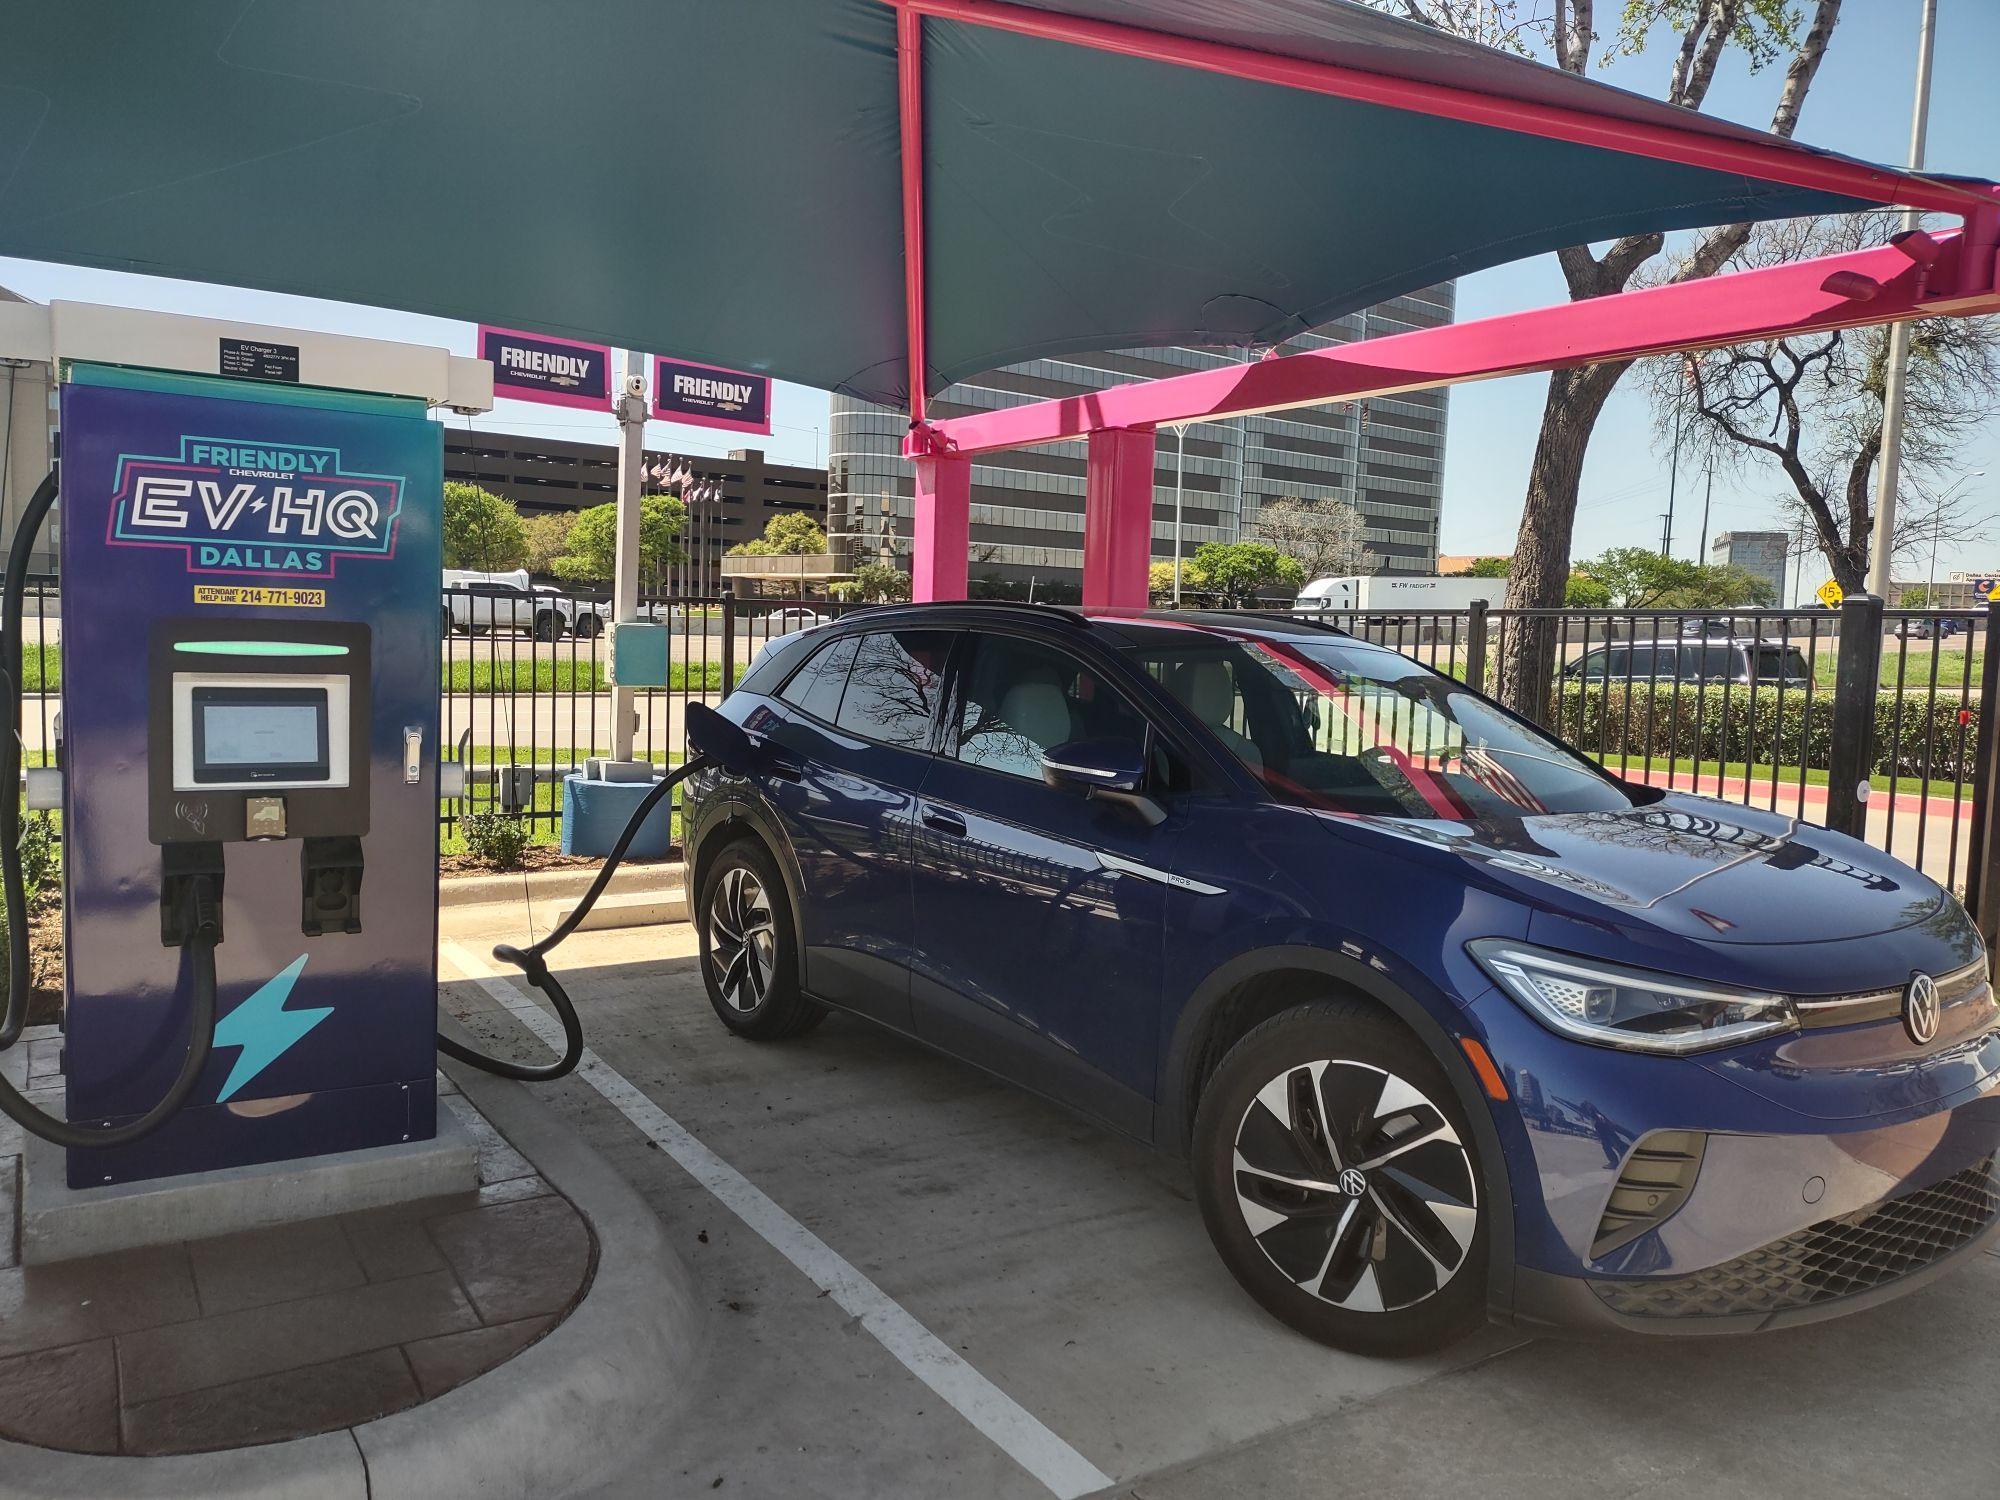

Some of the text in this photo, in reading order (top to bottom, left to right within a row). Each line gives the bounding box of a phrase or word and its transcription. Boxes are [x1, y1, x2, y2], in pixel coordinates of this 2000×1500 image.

[501, 346, 590, 378] FRIENDLY
[510, 370, 547, 380] CHEVROLET
[674, 374, 752, 404] FRIENDLY
[682, 397, 715, 406] CHEVROLET
[193, 444, 330, 474] FRIENDLY
[229, 468, 295, 480] CHEVROLET
[200, 546, 323, 571] DALLAS
[198, 587, 239, 596] ATTENDANT
[200, 594, 219, 602] HELP
[241, 589, 322, 605] 214-771-9023
